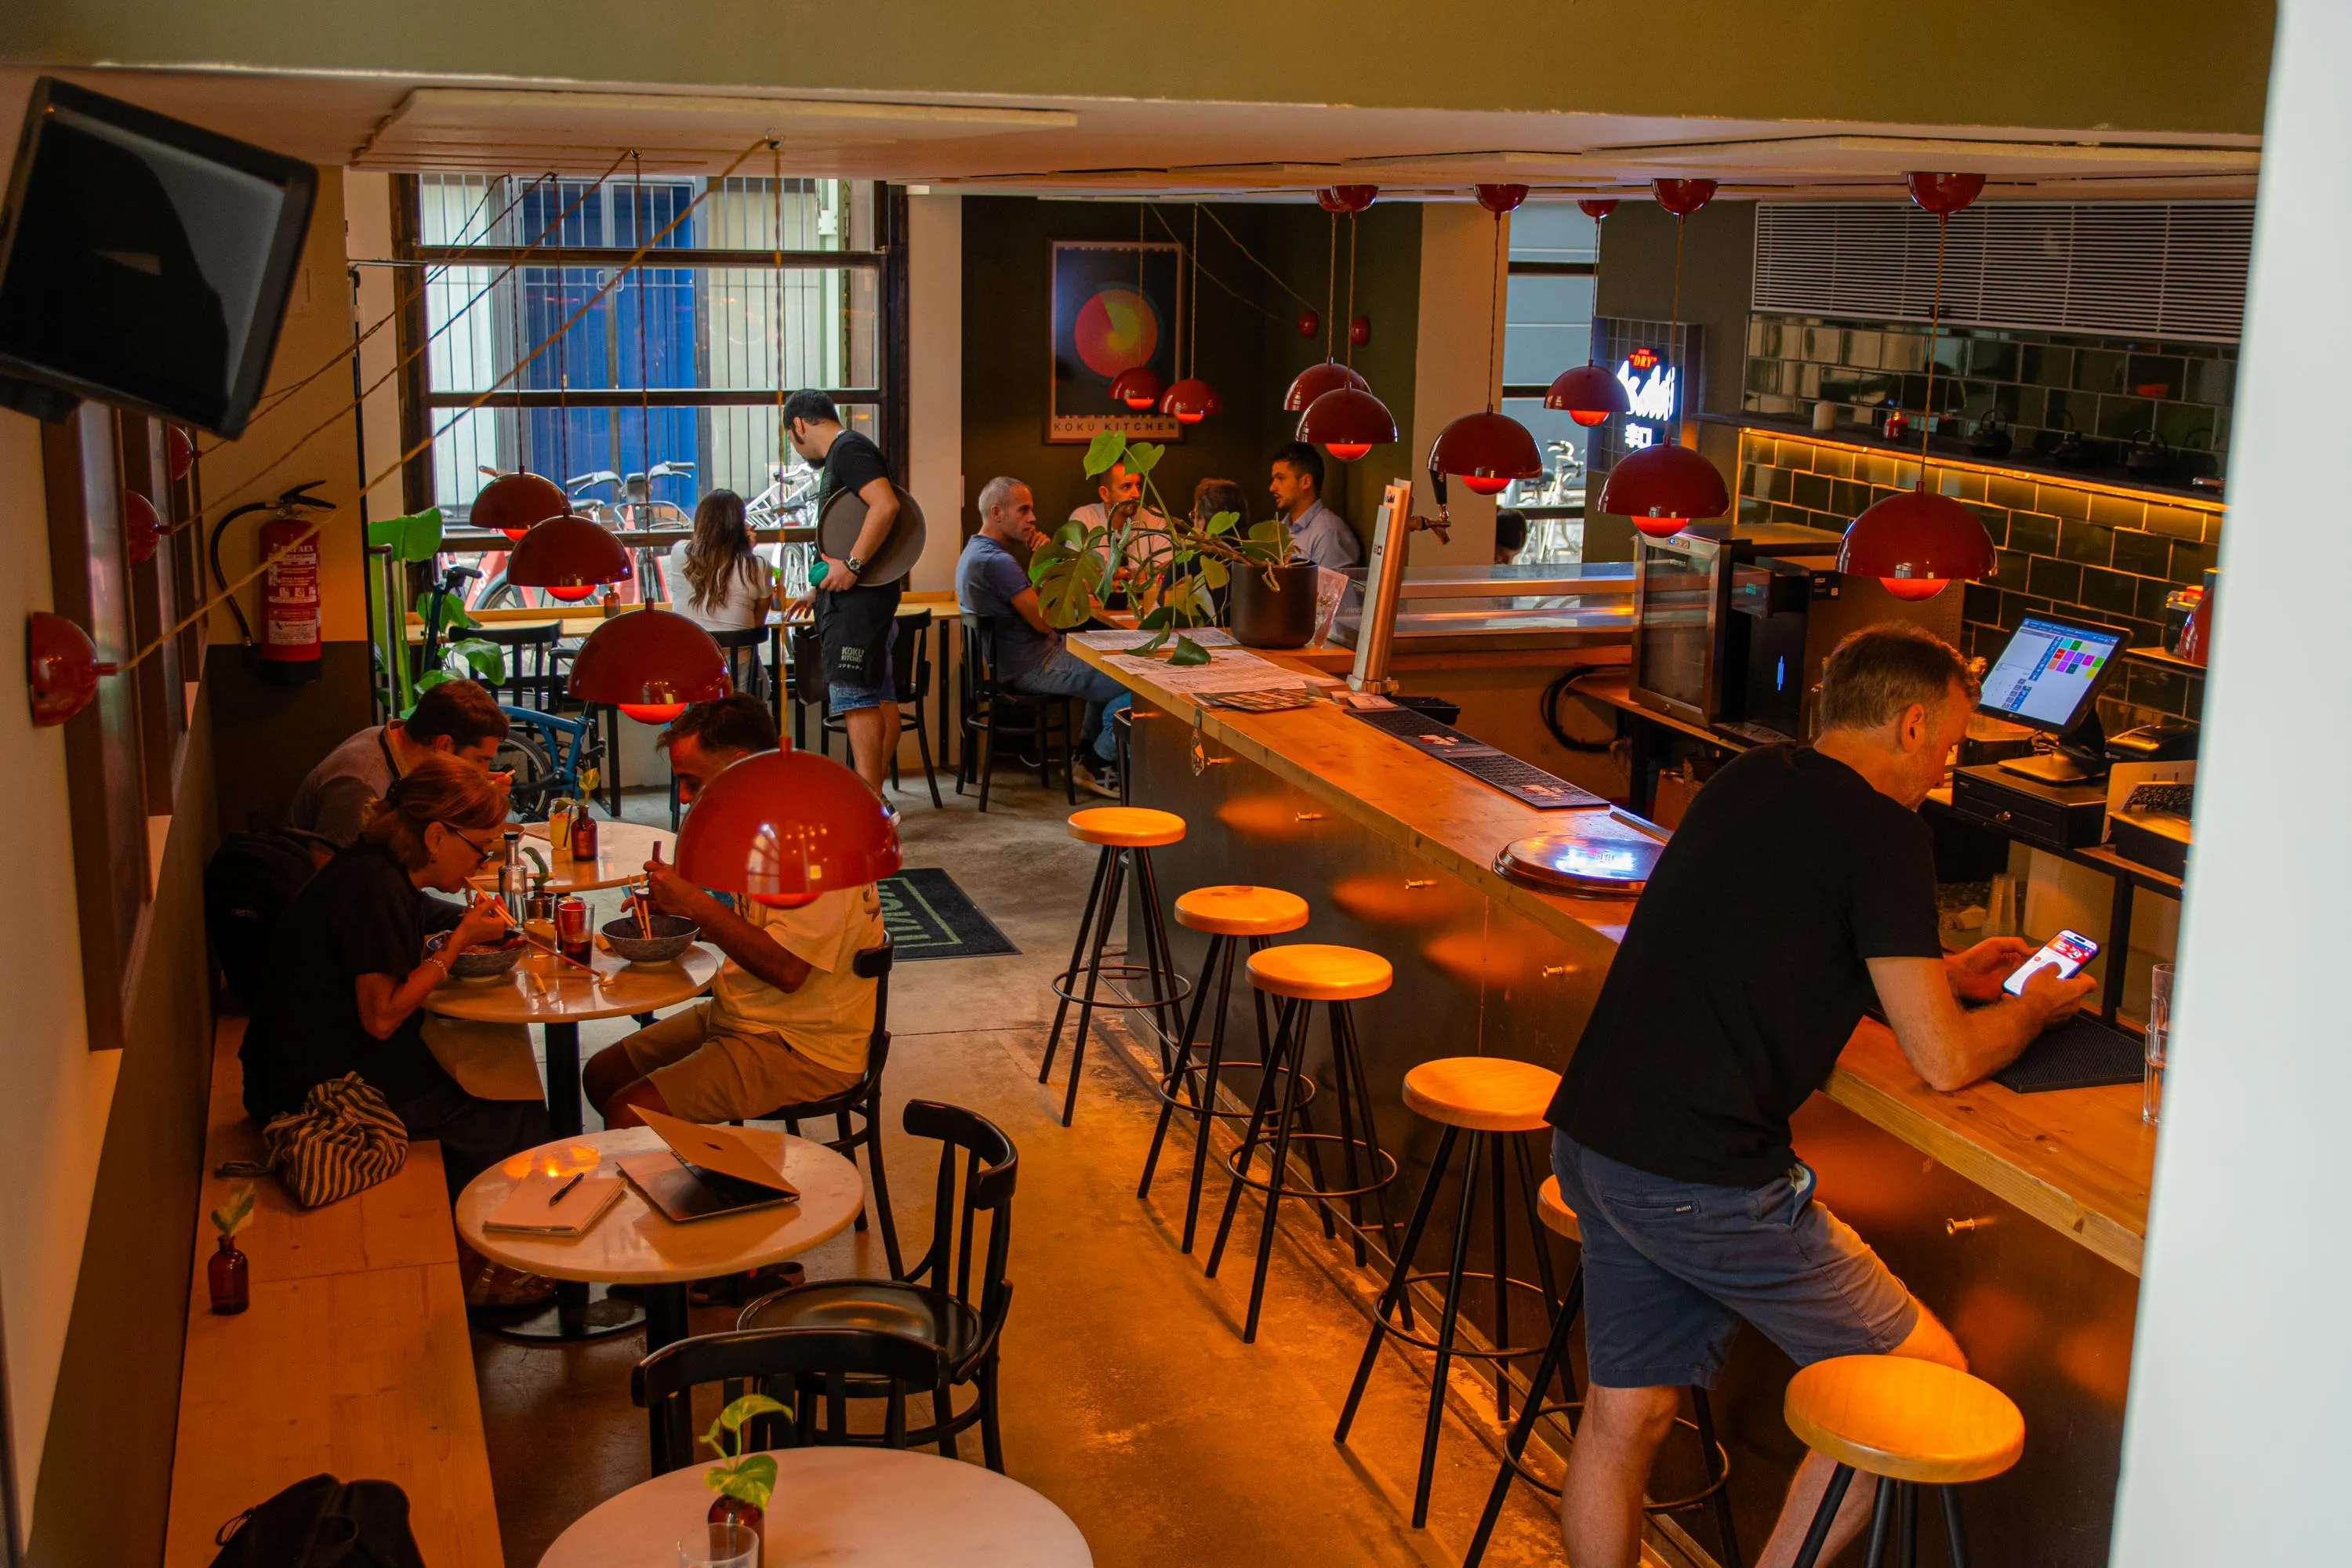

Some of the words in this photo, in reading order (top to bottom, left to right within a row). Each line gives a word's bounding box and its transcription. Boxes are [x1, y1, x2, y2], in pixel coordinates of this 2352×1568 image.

[1054, 422, 1095, 432] KOKU
[1104, 421, 1176, 431] KITCHEN
[841, 645, 866, 658] KOKU
